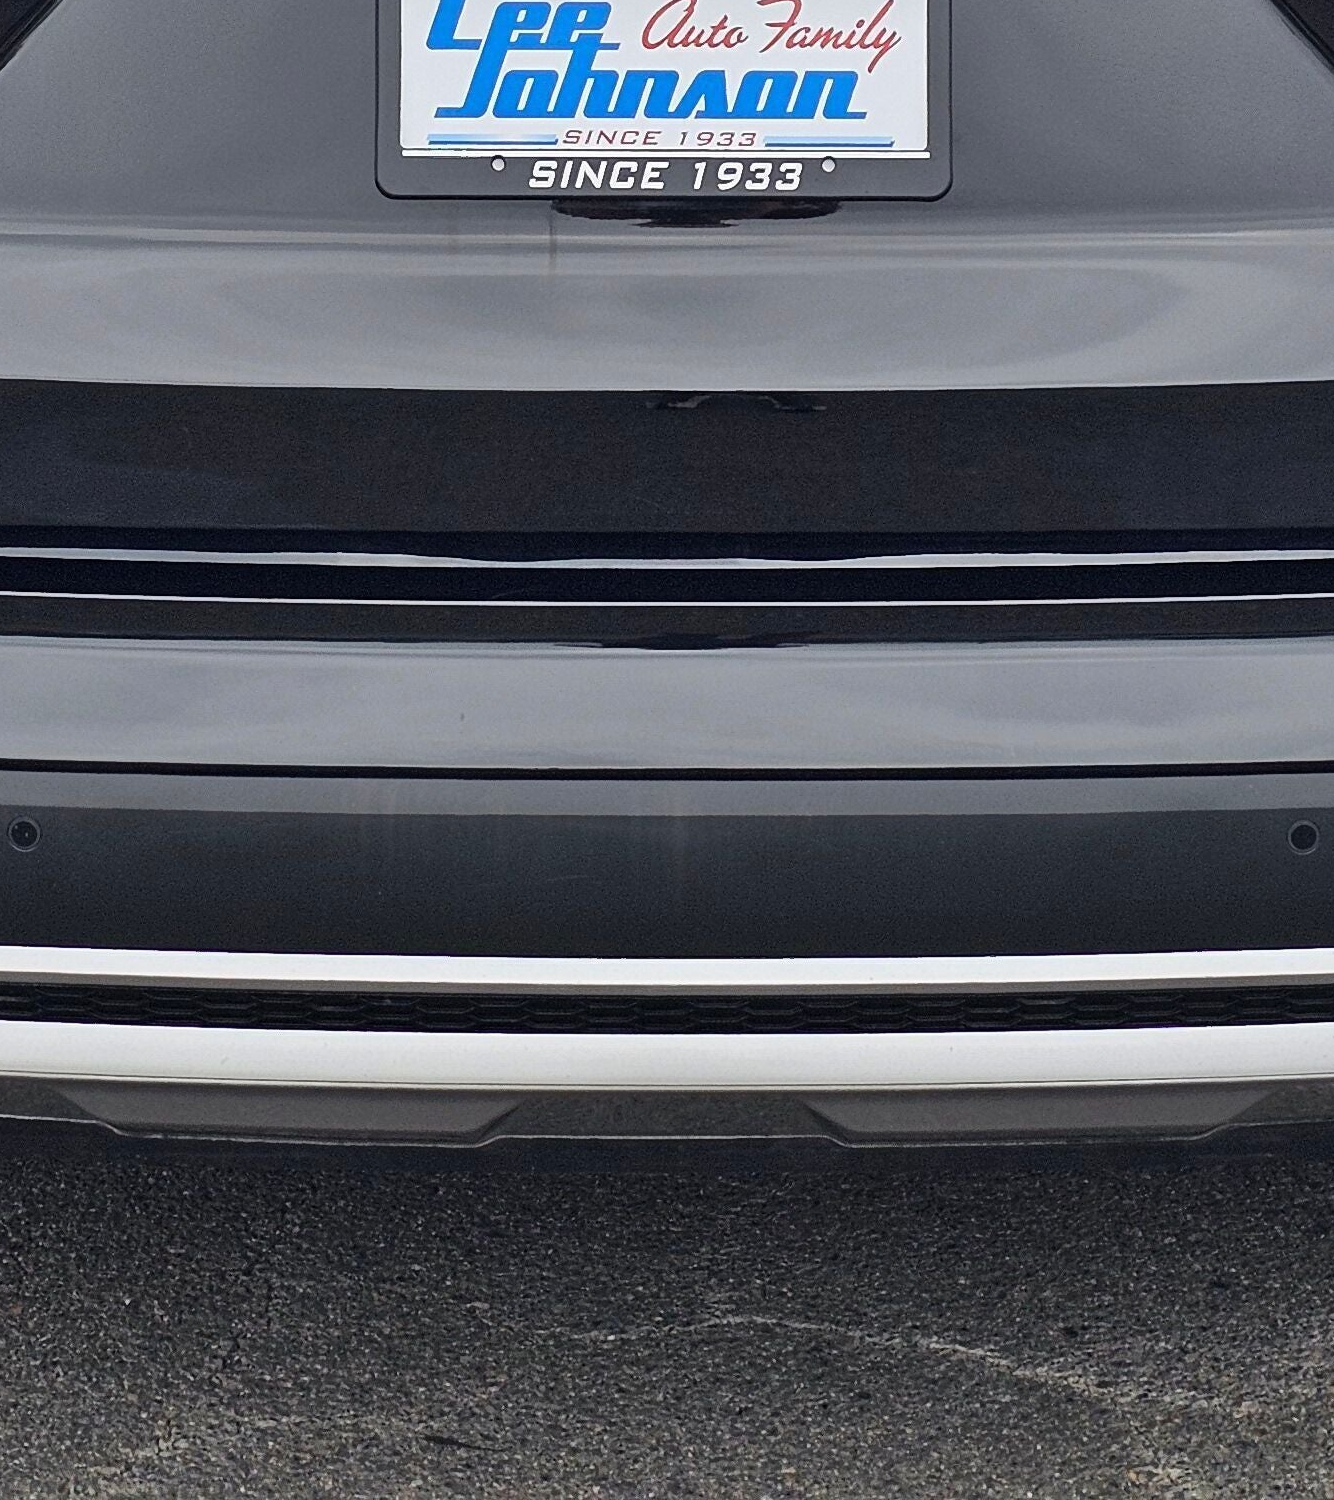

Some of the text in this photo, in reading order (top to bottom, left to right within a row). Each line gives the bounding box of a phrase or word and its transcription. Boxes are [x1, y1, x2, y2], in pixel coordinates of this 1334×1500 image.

[434, 33, 868, 120] Johnson
[562, 129, 757, 147] SINCE 1933
[528, 160, 803, 191] SINCE 1933
